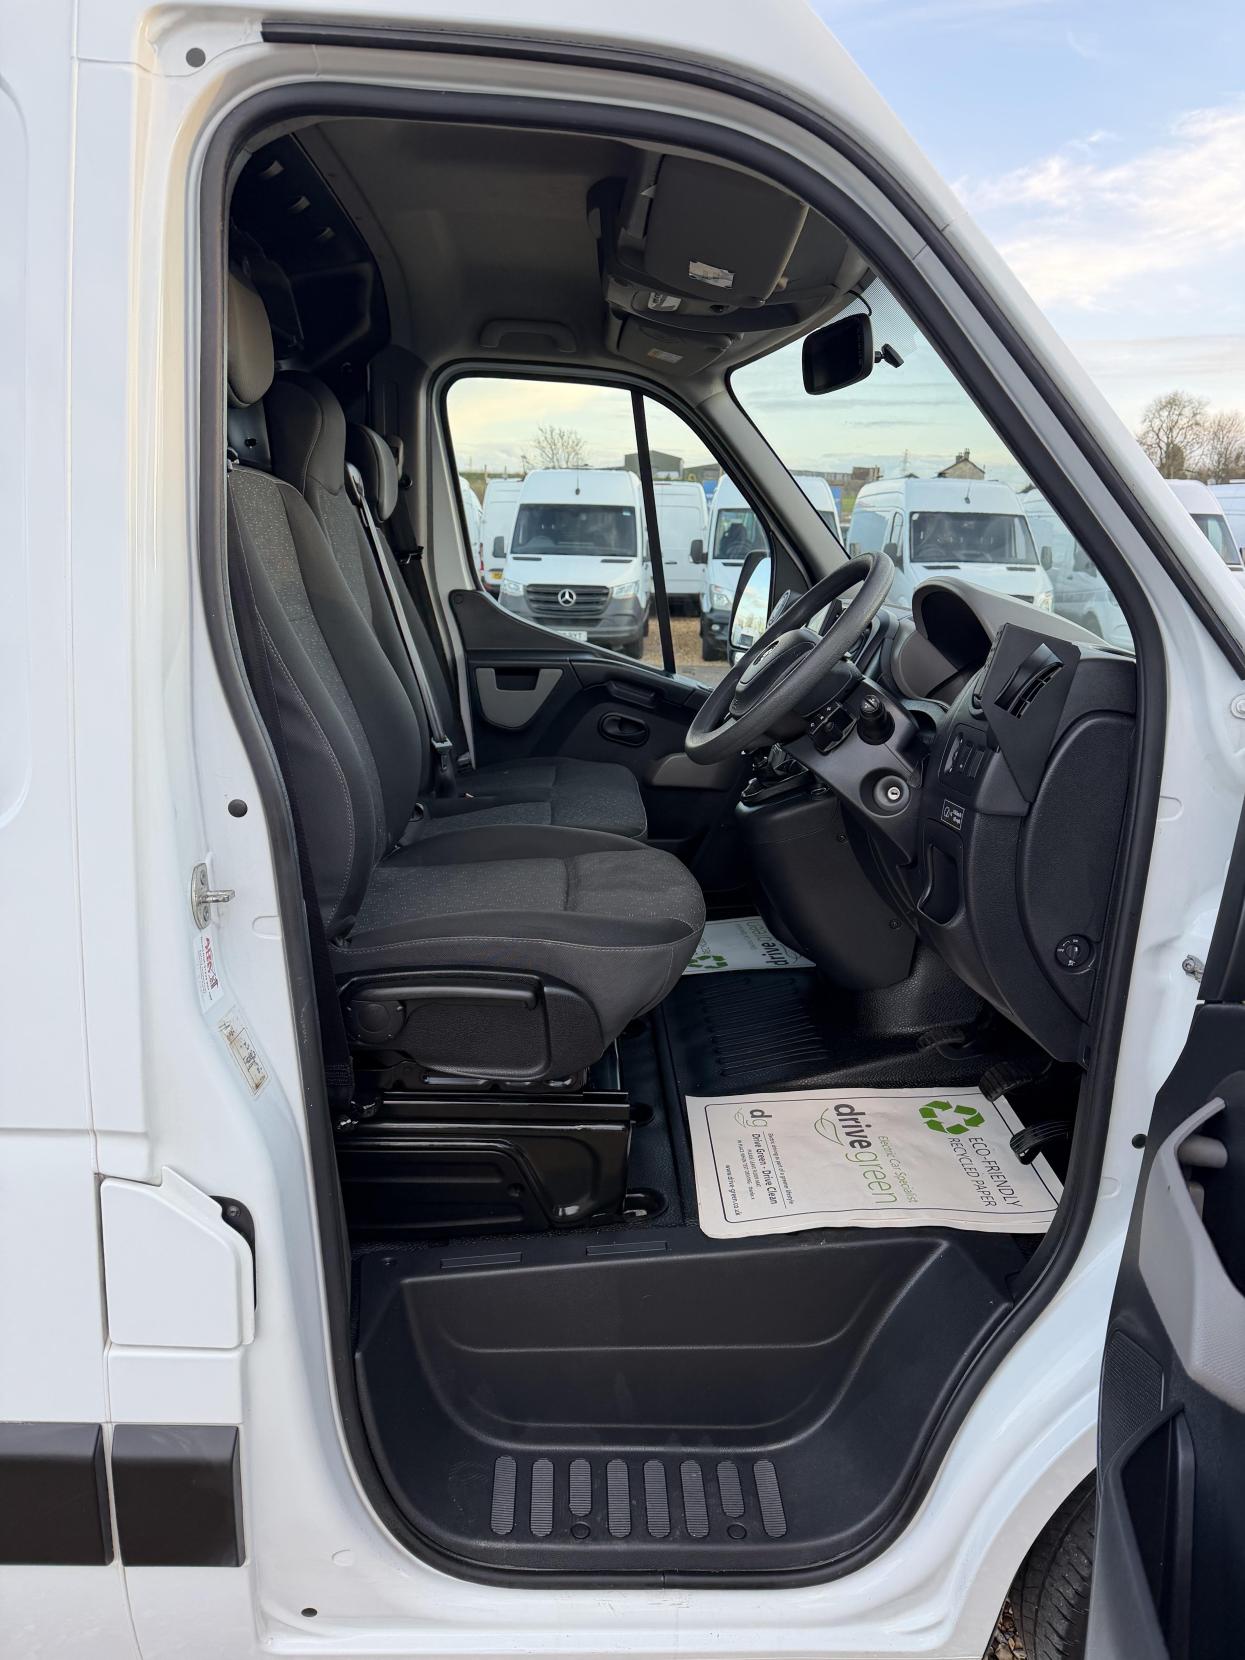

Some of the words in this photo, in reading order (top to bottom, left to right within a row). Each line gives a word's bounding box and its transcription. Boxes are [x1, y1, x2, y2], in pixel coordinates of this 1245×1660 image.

[752, 1133, 762, 1148] Drive
[878, 1135, 896, 1158] Electric
[756, 1148, 767, 1166] Green
[889, 1158, 901, 1171] Car
[762, 1169, 774, 1186] Drive
[947, 1137, 980, 1178] RECYCLED
[970, 1180, 997, 1207] PAPER
[968, 1137, 1024, 1207] ECO-FRIENDLY
[767, 1186, 778, 1205] Clean
[894, 1171, 918, 1203] Specialist
